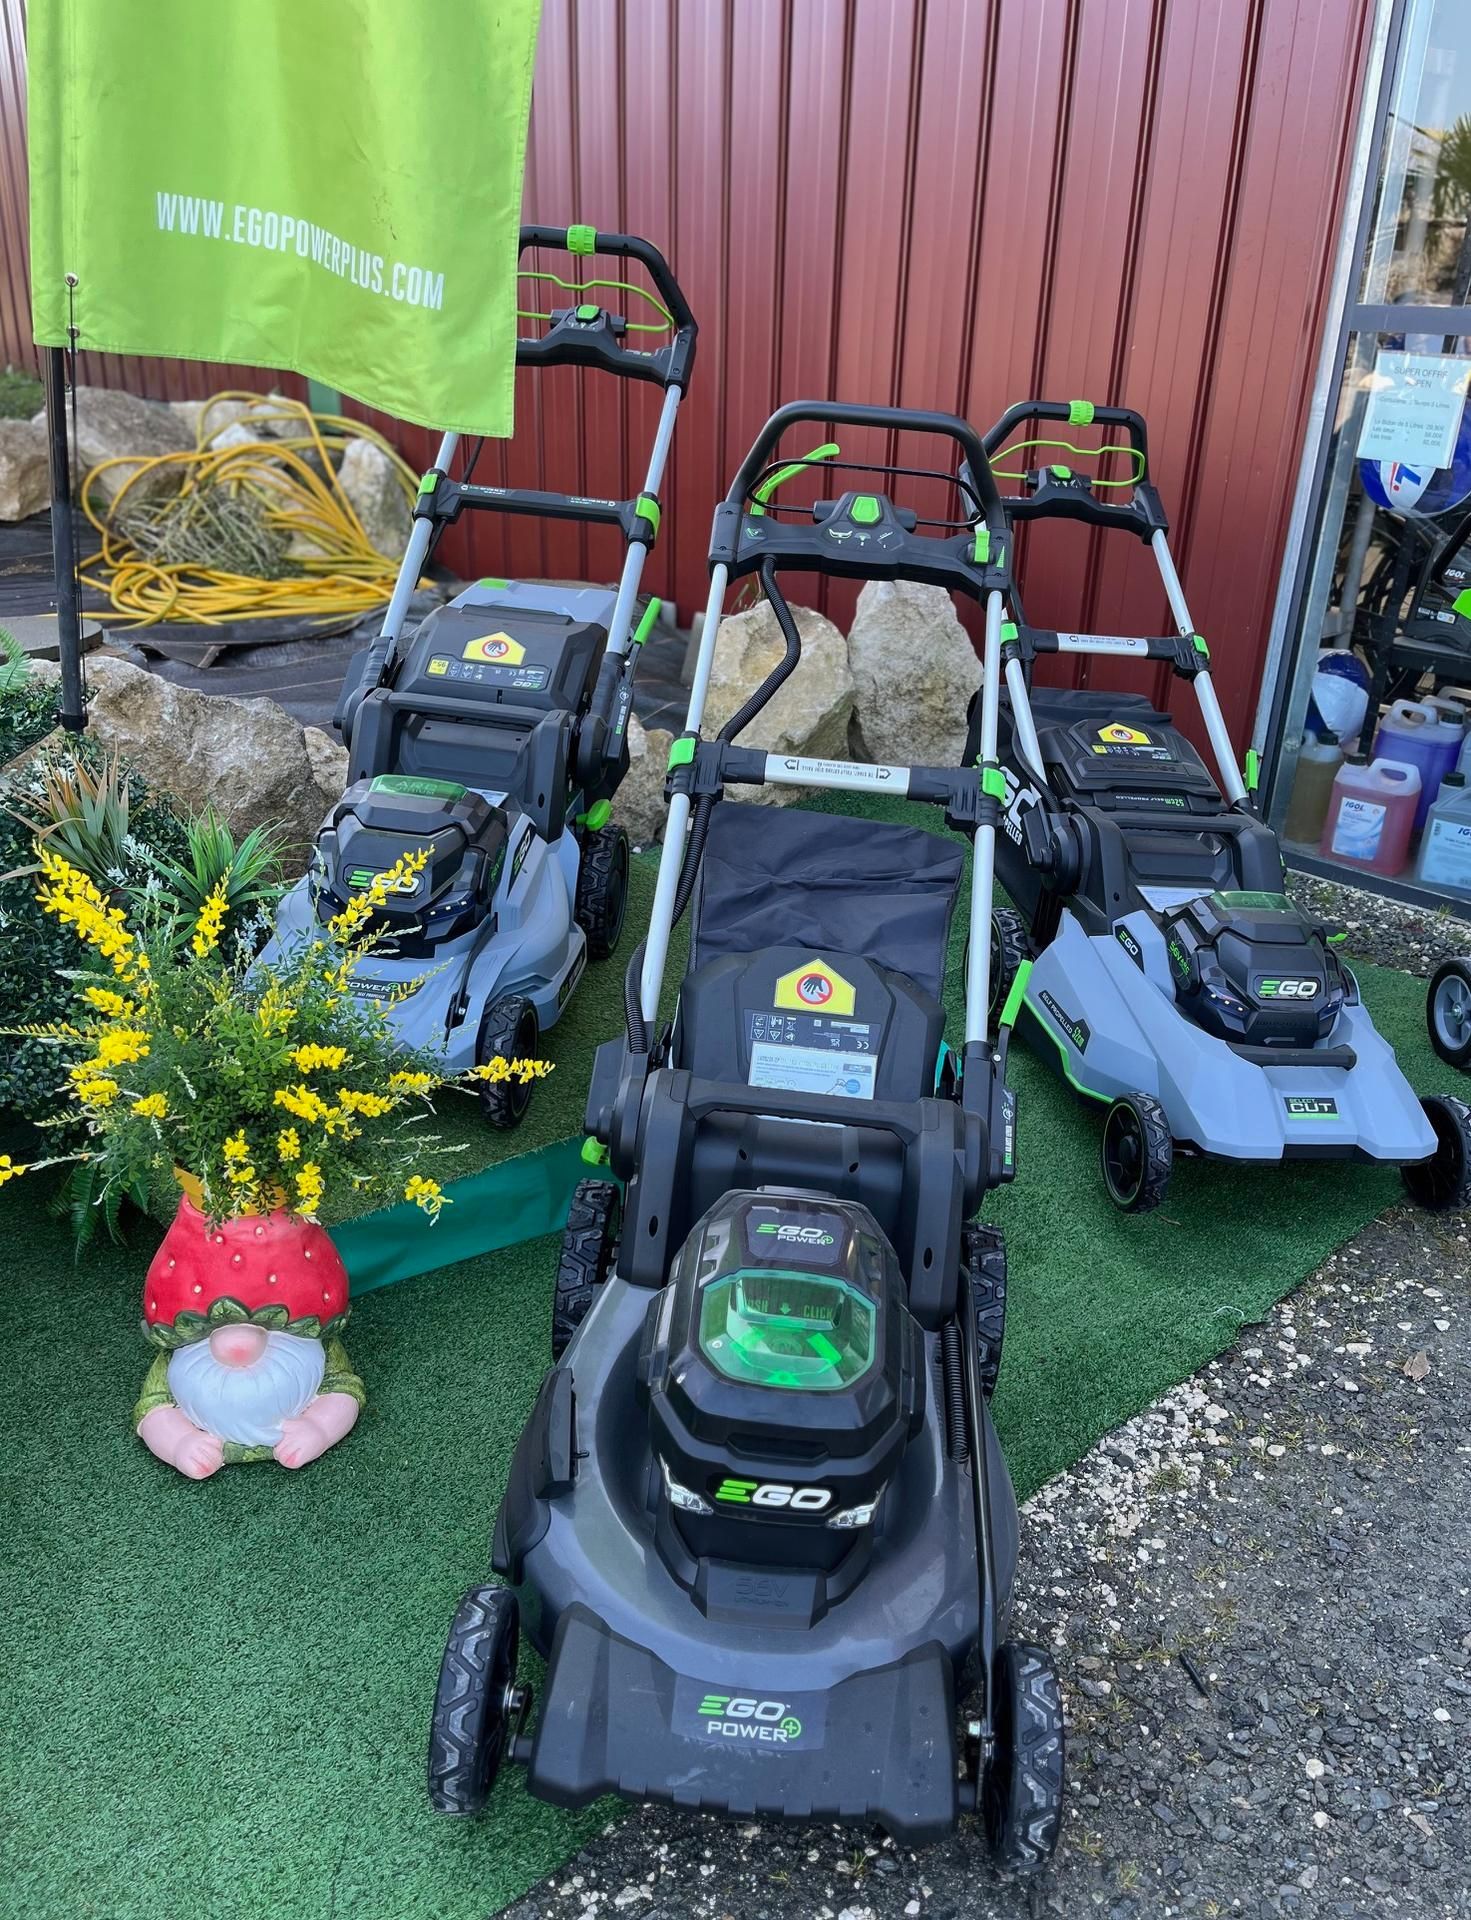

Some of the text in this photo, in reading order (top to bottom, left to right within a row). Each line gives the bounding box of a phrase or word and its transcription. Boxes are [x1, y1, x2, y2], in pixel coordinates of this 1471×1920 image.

[157, 191, 444, 310] WWW.EGOPOWERPLUS.COM
[1394, 366, 1421, 377] SUPER
[1444, 568, 1466, 579] IGOL
[1345, 801, 1365, 811] IGOL
[1119, 930, 1139, 956] EGO
[1259, 980, 1318, 996] EGO
[1050, 1003, 1074, 1034] PROPELLED
[1289, 1103, 1332, 1113] CUT
[756, 1223, 824, 1238] EGO
[715, 1479, 832, 1510] EGO
[697, 1695, 786, 1721] EGO
